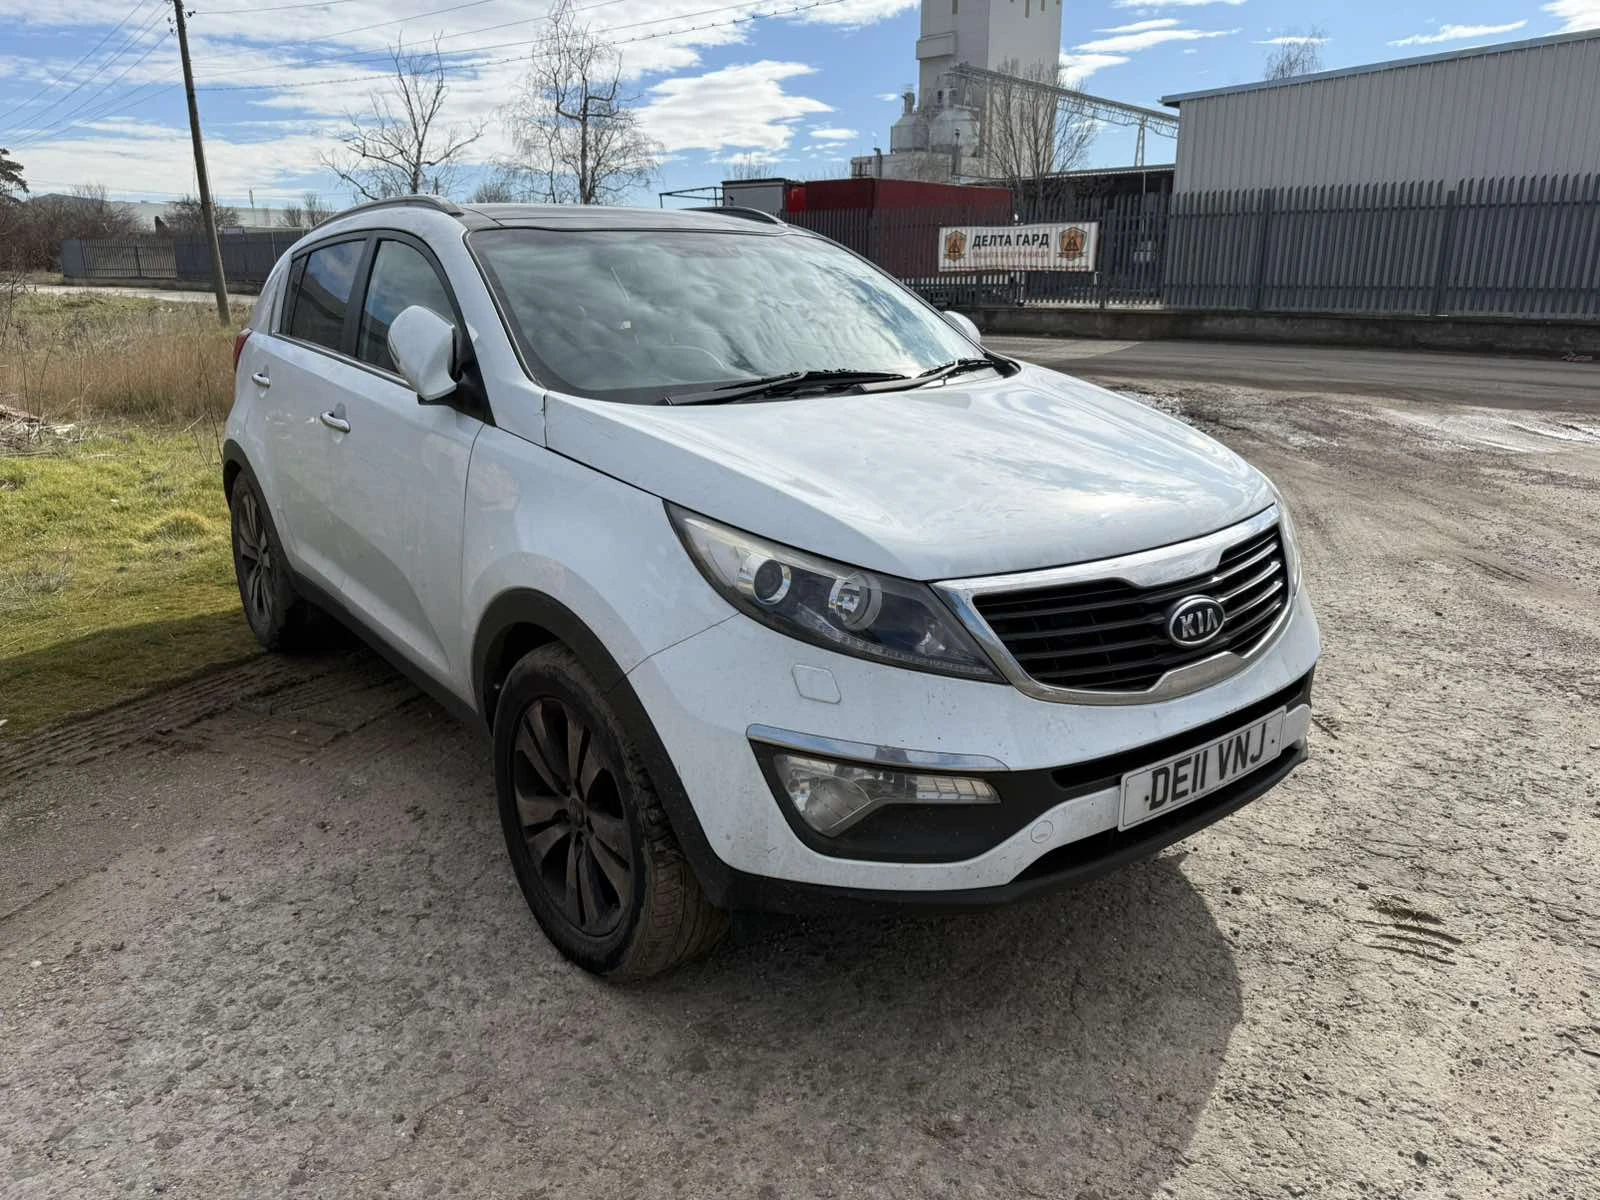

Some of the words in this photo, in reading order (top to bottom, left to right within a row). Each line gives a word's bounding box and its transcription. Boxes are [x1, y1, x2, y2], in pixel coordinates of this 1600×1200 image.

[972, 234, 1012, 249] ДЕЛТА
[1016, 233, 1049, 248] ГАРД
[1179, 608, 1218, 639] KIA
[1149, 750, 1208, 811] DE11
[1218, 723, 1267, 780] VNJ
